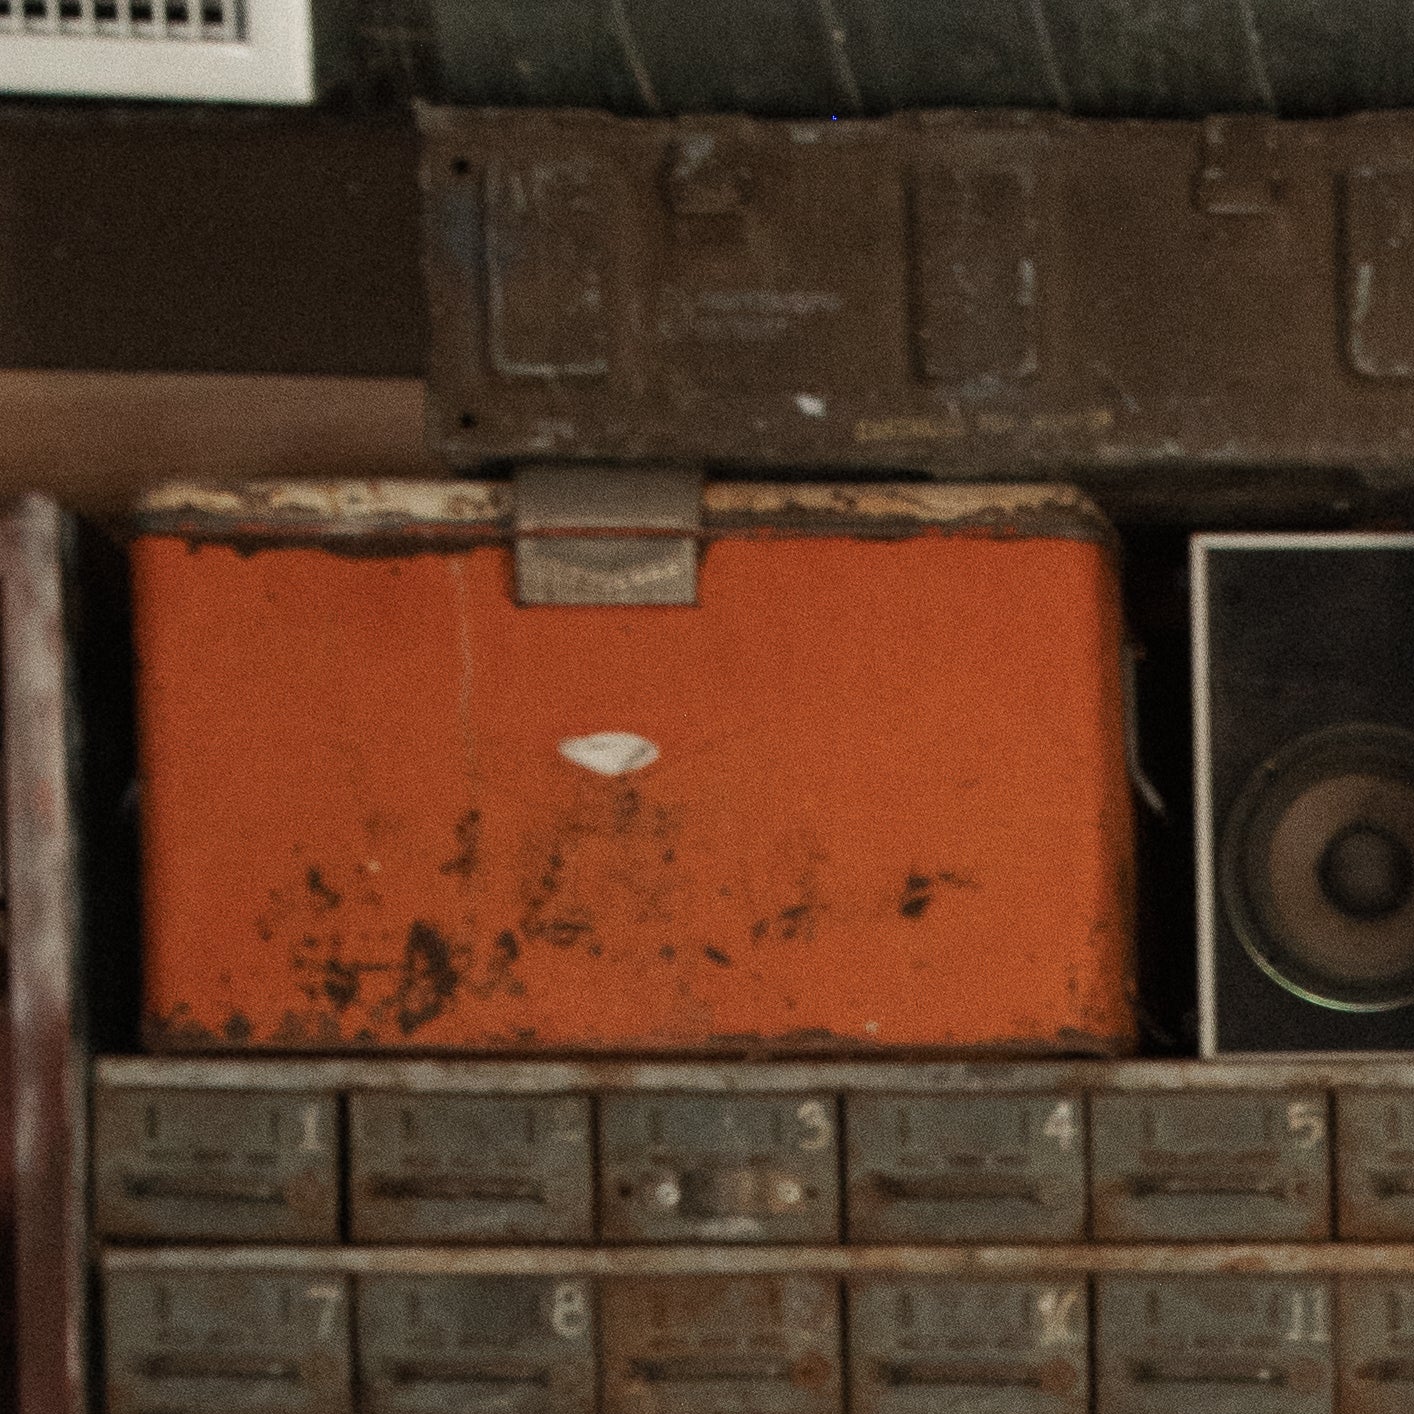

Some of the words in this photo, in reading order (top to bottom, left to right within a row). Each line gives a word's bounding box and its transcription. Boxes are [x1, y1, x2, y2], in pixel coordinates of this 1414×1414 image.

[797, 1100, 831, 1150] 3
[1042, 1101, 1076, 1150] 4
[1286, 1101, 1325, 1151] 5
[304, 1286, 341, 1338] 7
[551, 1284, 587, 1339] 8
